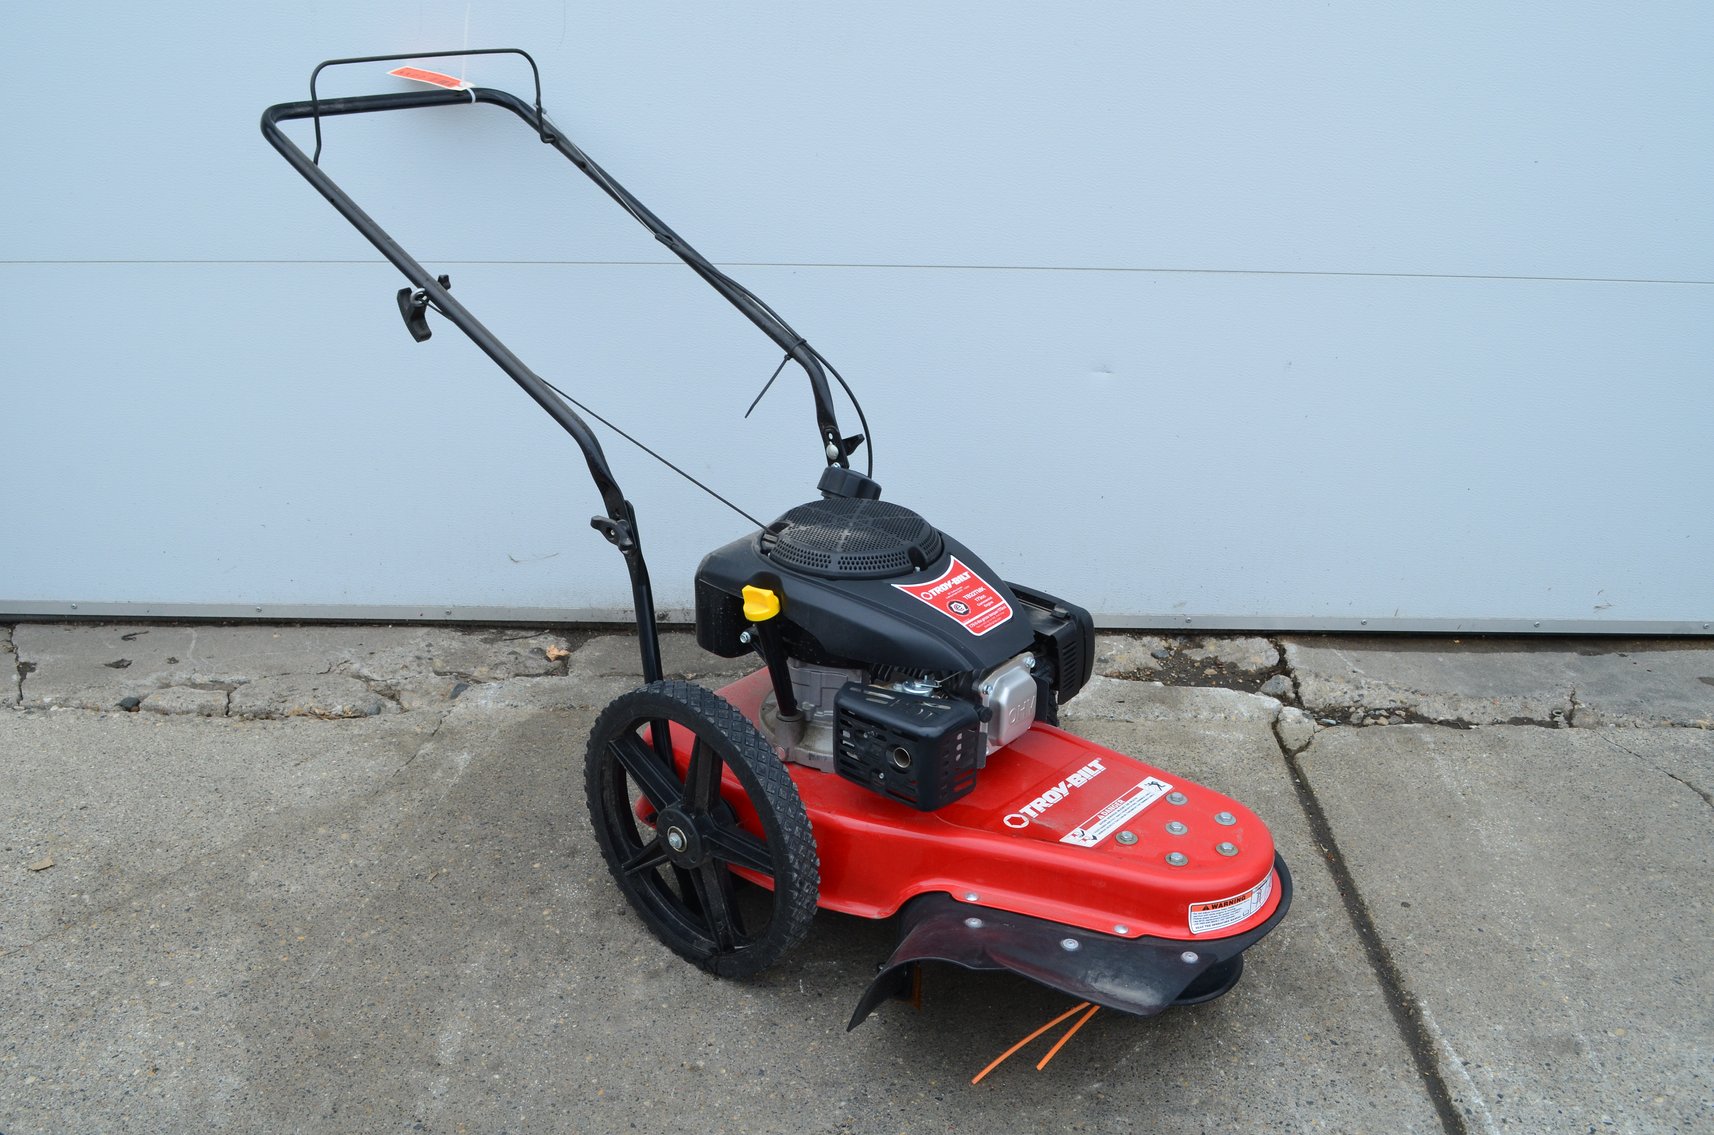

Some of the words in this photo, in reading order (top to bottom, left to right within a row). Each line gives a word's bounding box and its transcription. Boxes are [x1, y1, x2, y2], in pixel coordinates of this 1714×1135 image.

[928, 571, 971, 596] TROY-BILT
[1008, 695, 1036, 726] OHV
[1019, 759, 1106, 819] TROY-BILT
[1102, 799, 1126, 816] DANGER
[1211, 895, 1246, 910] WARNING
